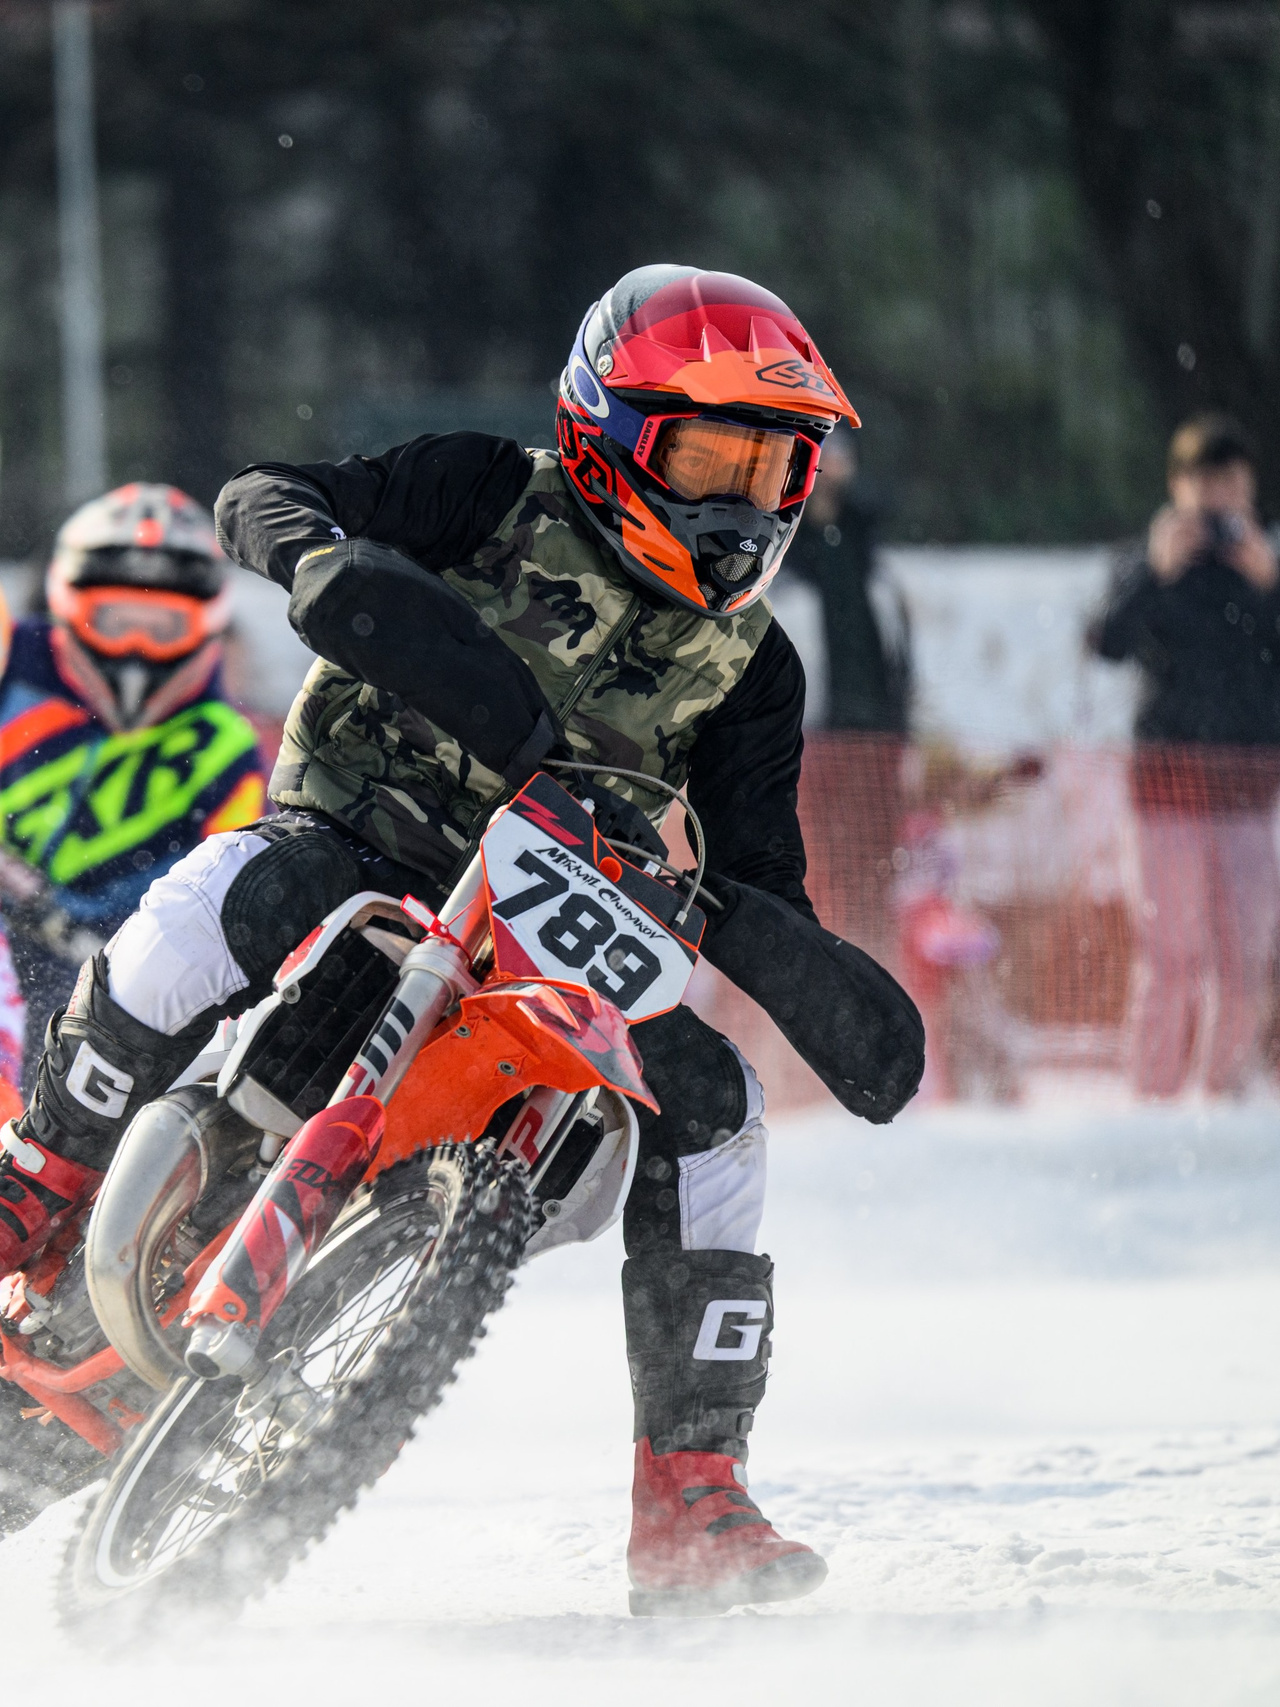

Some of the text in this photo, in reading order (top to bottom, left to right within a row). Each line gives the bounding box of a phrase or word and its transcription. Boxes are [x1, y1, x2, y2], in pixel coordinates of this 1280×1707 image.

[637, 420, 654, 458] OAKLEY
[491, 849, 663, 1011] 789
[66, 1040, 135, 1119] G
[283, 1158, 341, 1196] FOX
[692, 1299, 768, 1361] G
